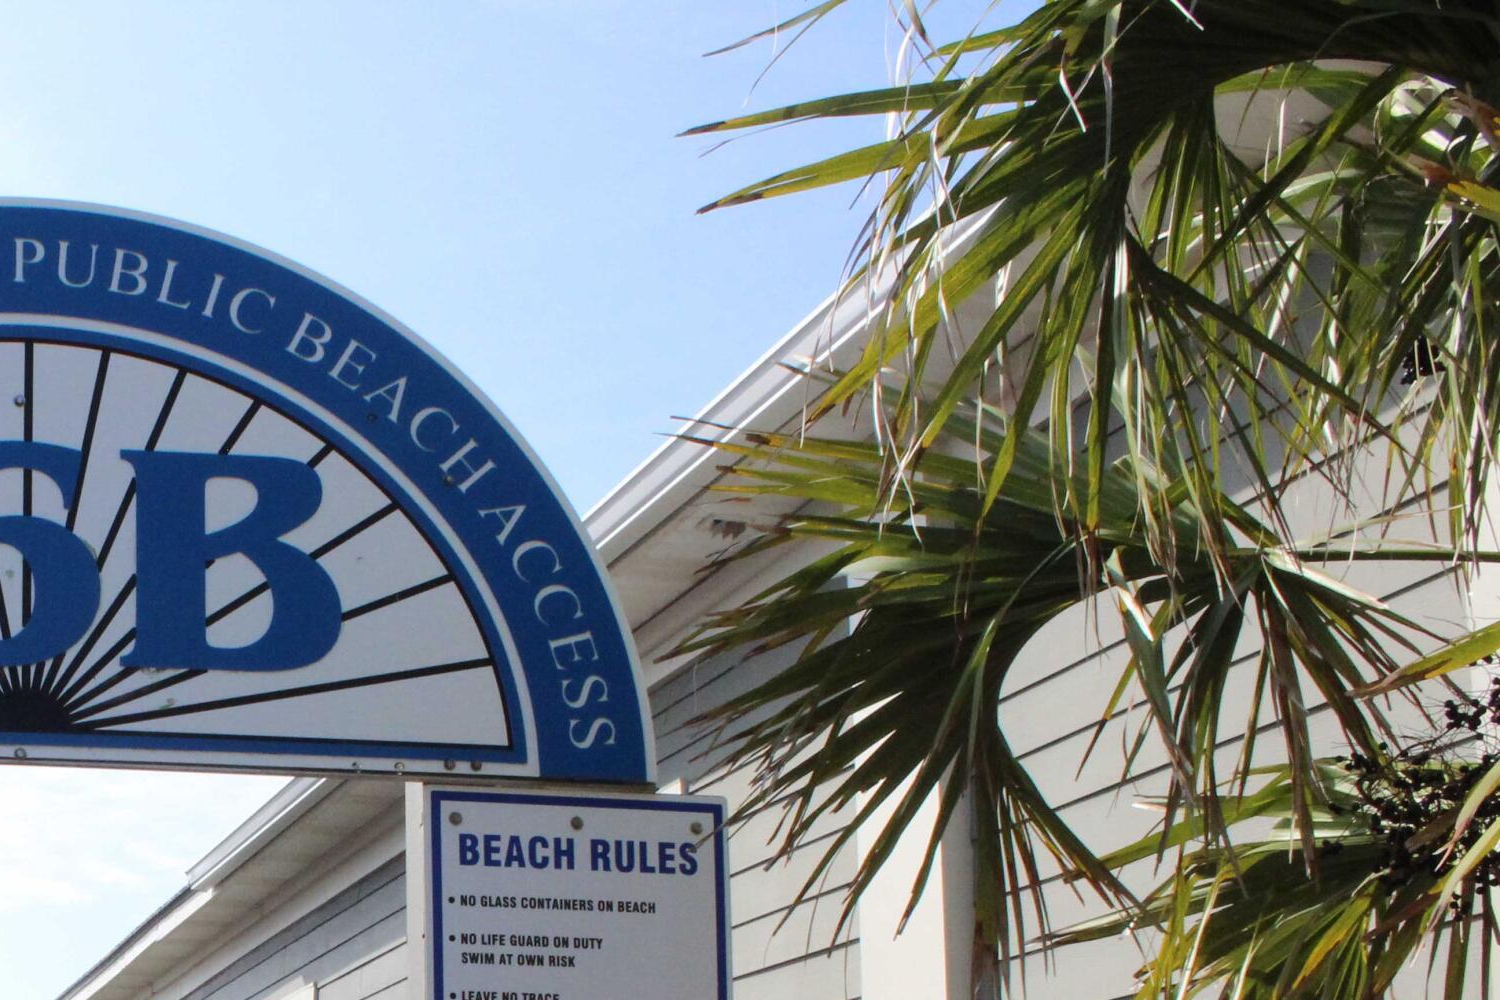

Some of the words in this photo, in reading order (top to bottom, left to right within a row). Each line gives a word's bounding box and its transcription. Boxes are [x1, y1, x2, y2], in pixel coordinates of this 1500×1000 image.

[13, 237, 276, 335] PUBLIC
[285, 312, 497, 495] BEACH
[479, 504, 616, 749] ACCESS
[459, 833, 575, 870] BEACH
[591, 839, 698, 875] RULES
[460, 895, 476, 906] NO
[480, 896, 516, 908] GLASS
[521, 898, 593, 911] CONTAINERS
[598, 901, 613, 912] ON
[618, 901, 655, 913] BEACH
[461, 934, 476, 945] NO
[481, 935, 505, 946] LIFE
[510, 935, 549, 947] GUARD
[554, 937, 569, 948] ON
[574, 938, 602, 949] DUTY
[462, 953, 494, 964] SWIM
[500, 954, 513, 965] AT
[517, 955, 544, 966] OWN
[549, 956, 575, 967] RISK
